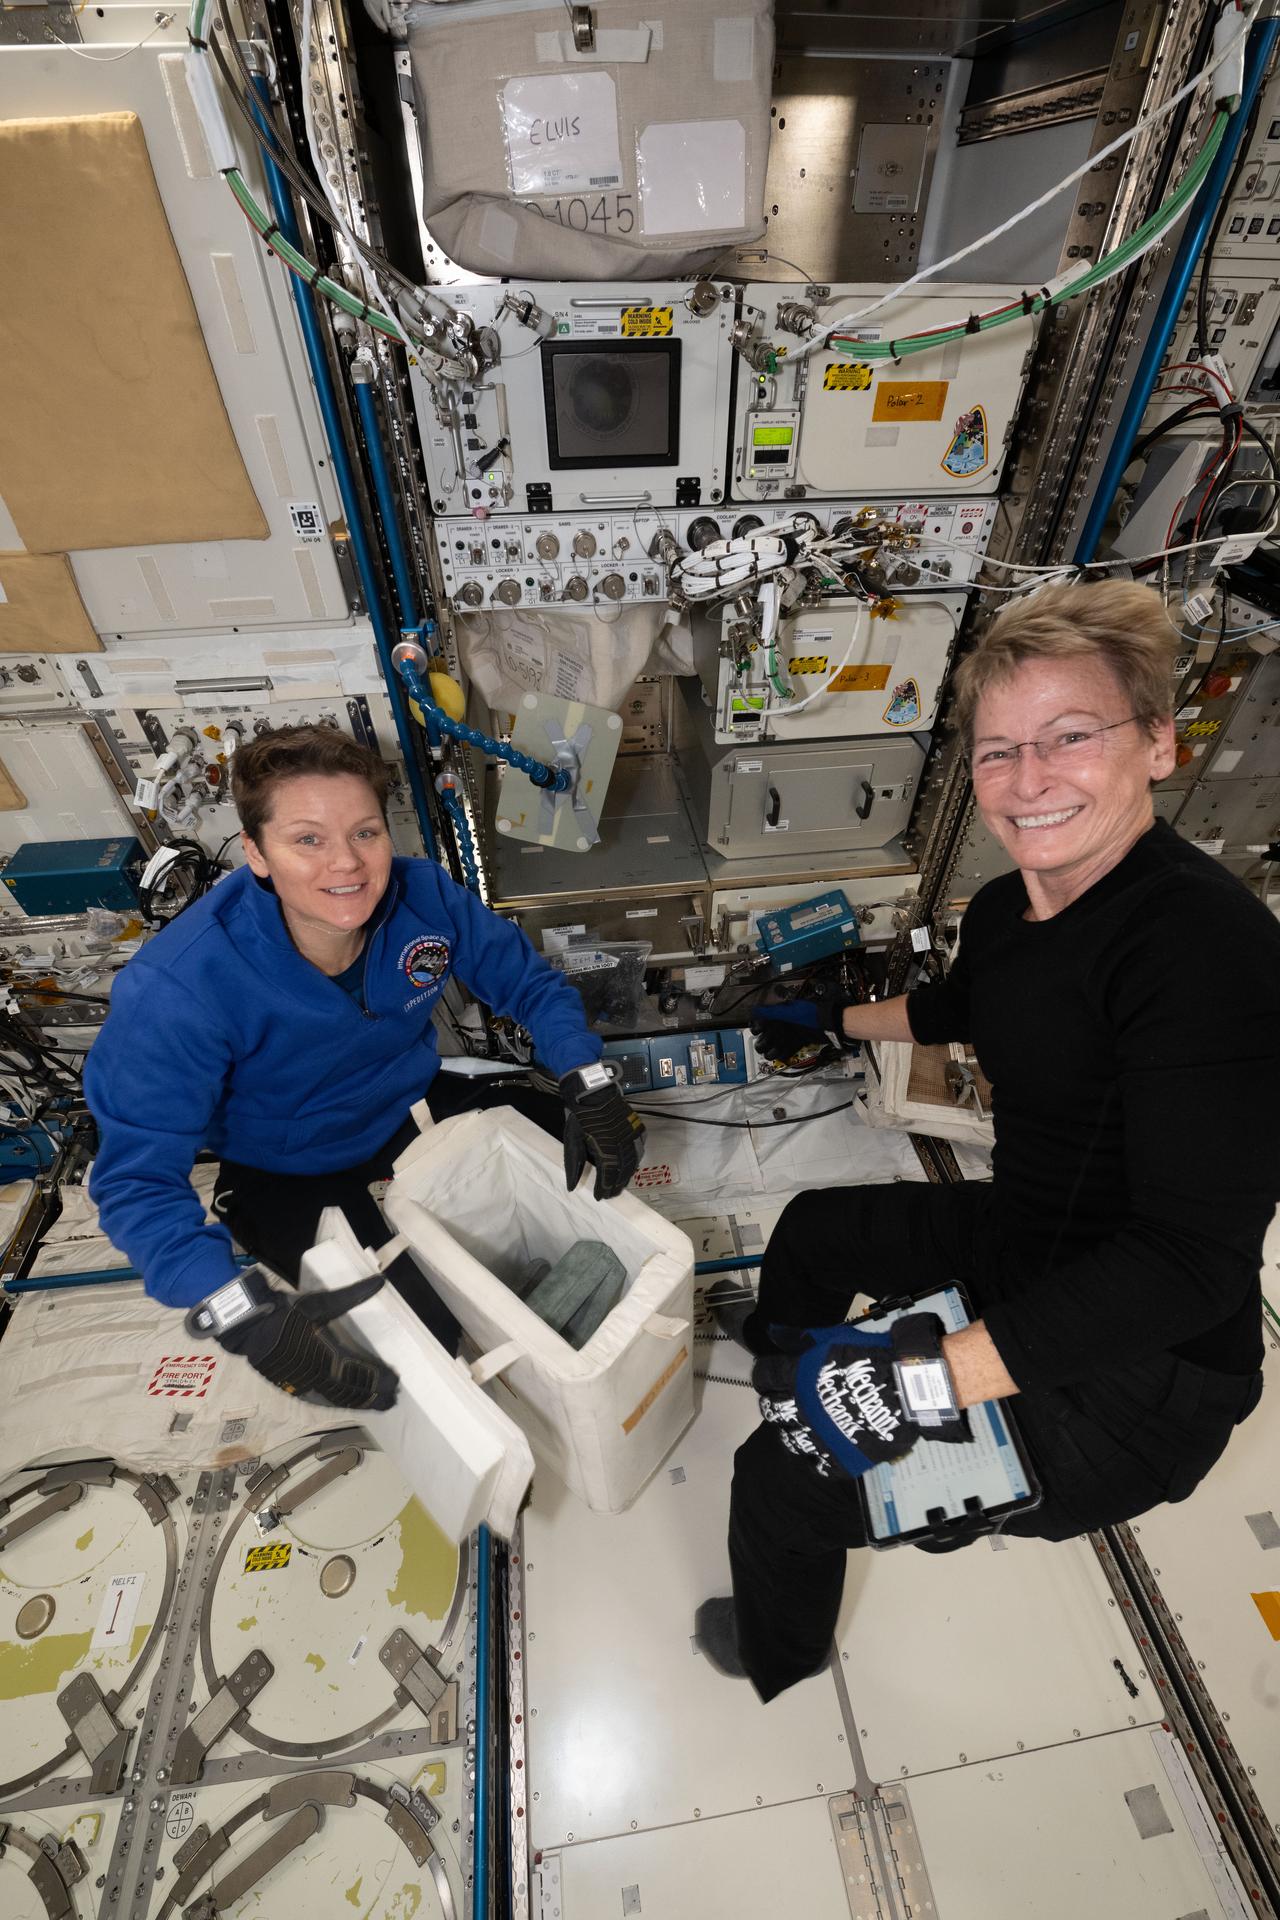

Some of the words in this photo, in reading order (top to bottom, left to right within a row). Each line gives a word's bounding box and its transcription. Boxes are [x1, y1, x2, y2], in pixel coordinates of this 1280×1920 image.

[529, 116, 580, 145] ELVIS
[397, 935, 421, 970] International
[404, 985, 438, 1013] EXPEDITION
[172, 1792, 192, 1802] DEWAR
[172, 1826, 177, 1834] C
